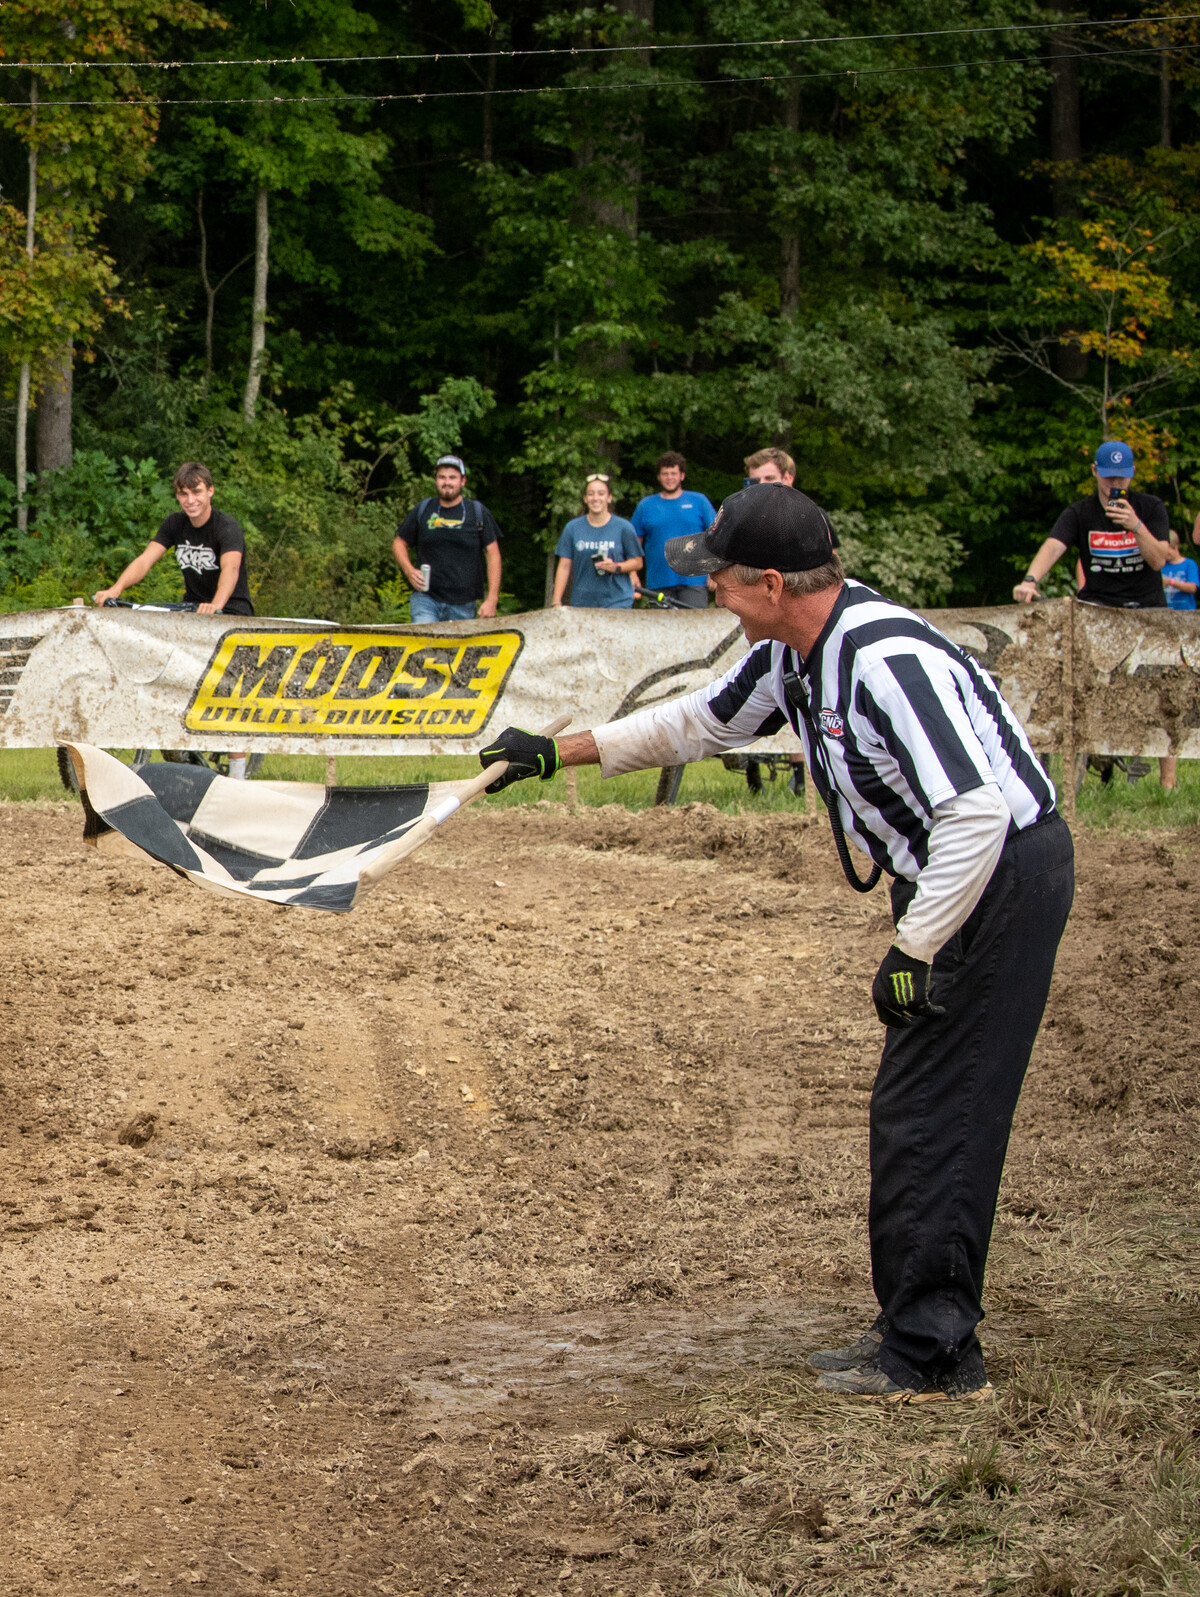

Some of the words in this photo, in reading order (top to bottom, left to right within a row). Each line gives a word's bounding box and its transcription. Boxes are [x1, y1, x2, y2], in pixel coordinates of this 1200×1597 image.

[212, 645, 502, 700] MOOSE
[200, 706, 318, 725] UTILITY
[325, 707, 477, 726] DIVISION
